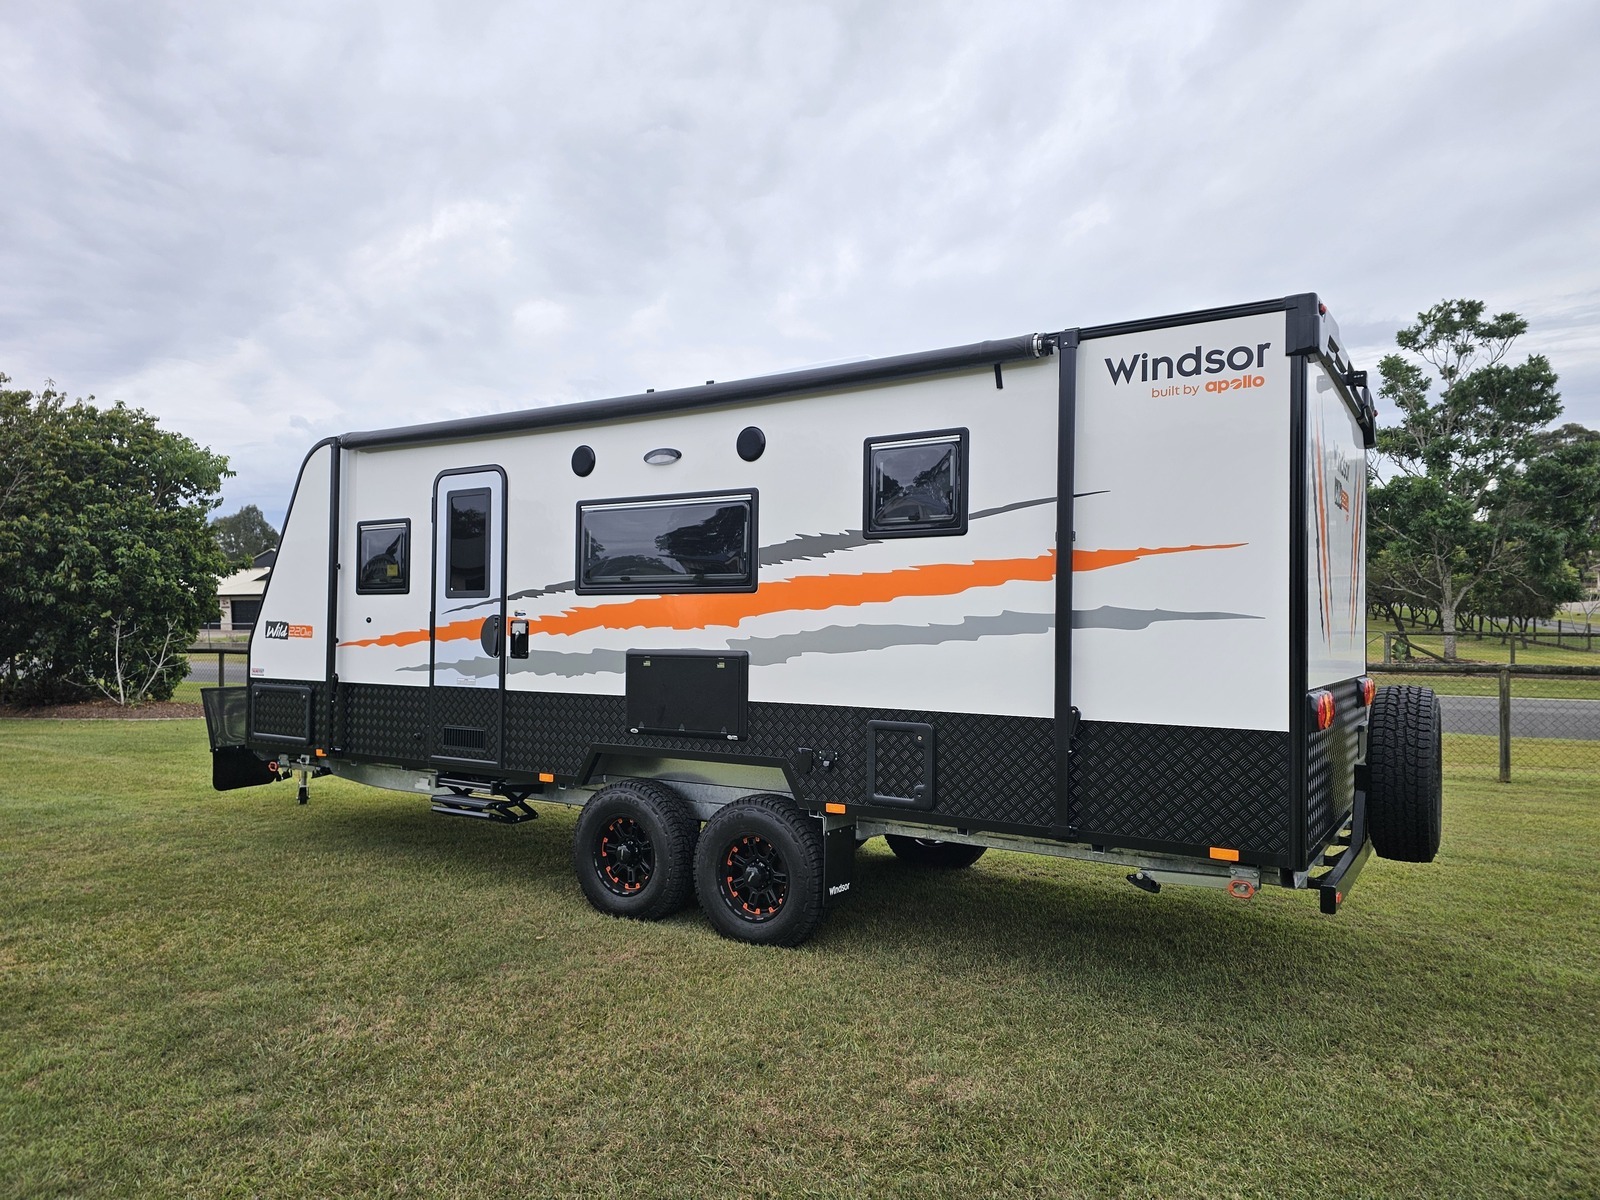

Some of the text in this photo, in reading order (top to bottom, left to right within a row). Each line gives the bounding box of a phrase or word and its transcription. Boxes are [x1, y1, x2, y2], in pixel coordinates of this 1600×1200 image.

[1104, 342, 1272, 386] Windsor
[1151, 374, 1265, 398] built by apollo
[266, 622, 288, 637] Wild
[829, 882, 850, 896] Windsor
